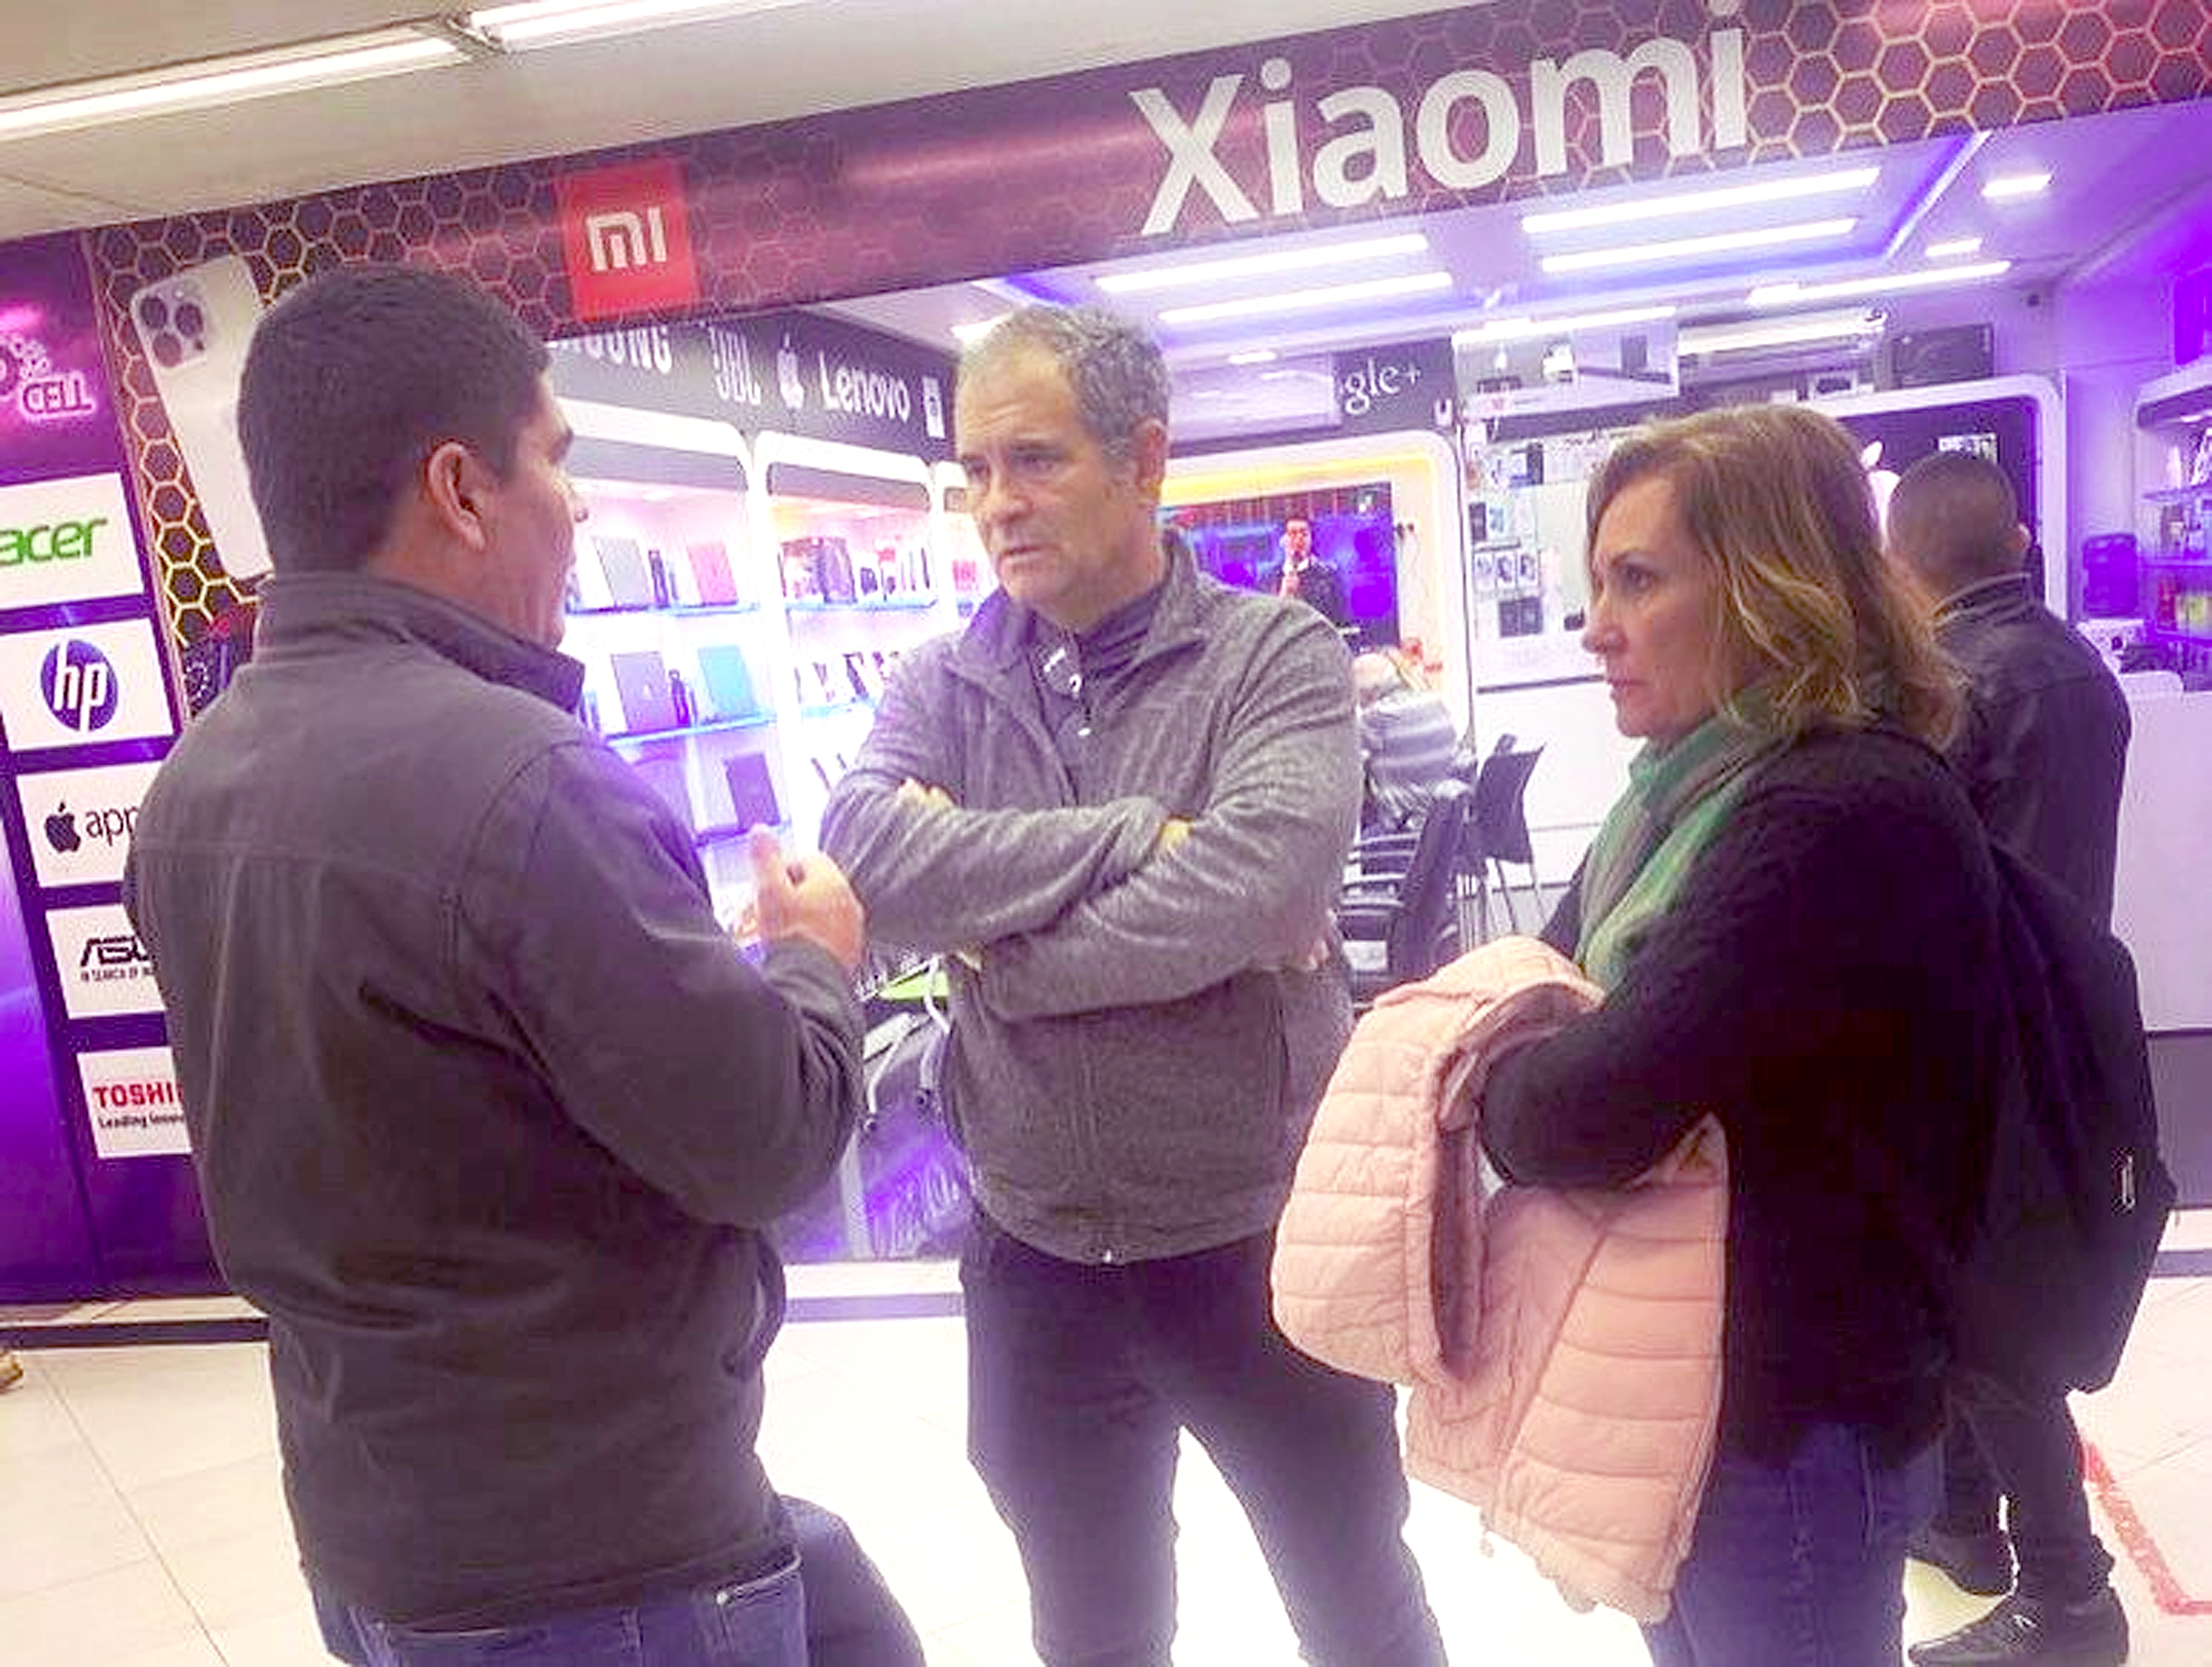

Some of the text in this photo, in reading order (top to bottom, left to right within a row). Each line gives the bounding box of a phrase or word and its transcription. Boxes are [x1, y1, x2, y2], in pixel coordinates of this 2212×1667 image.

[1128, 0, 1748, 236] Xiaomi
[22, 377, 93, 415] CELL
[818, 350, 911, 424] Lenovo
[1344, 357, 1422, 415] gle+
[0, 518, 108, 566] acer
[54, 638, 108, 732] hp
[86, 807, 139, 846] app
[80, 935, 154, 967] ASU
[92, 1081, 179, 1108] TOSHI
